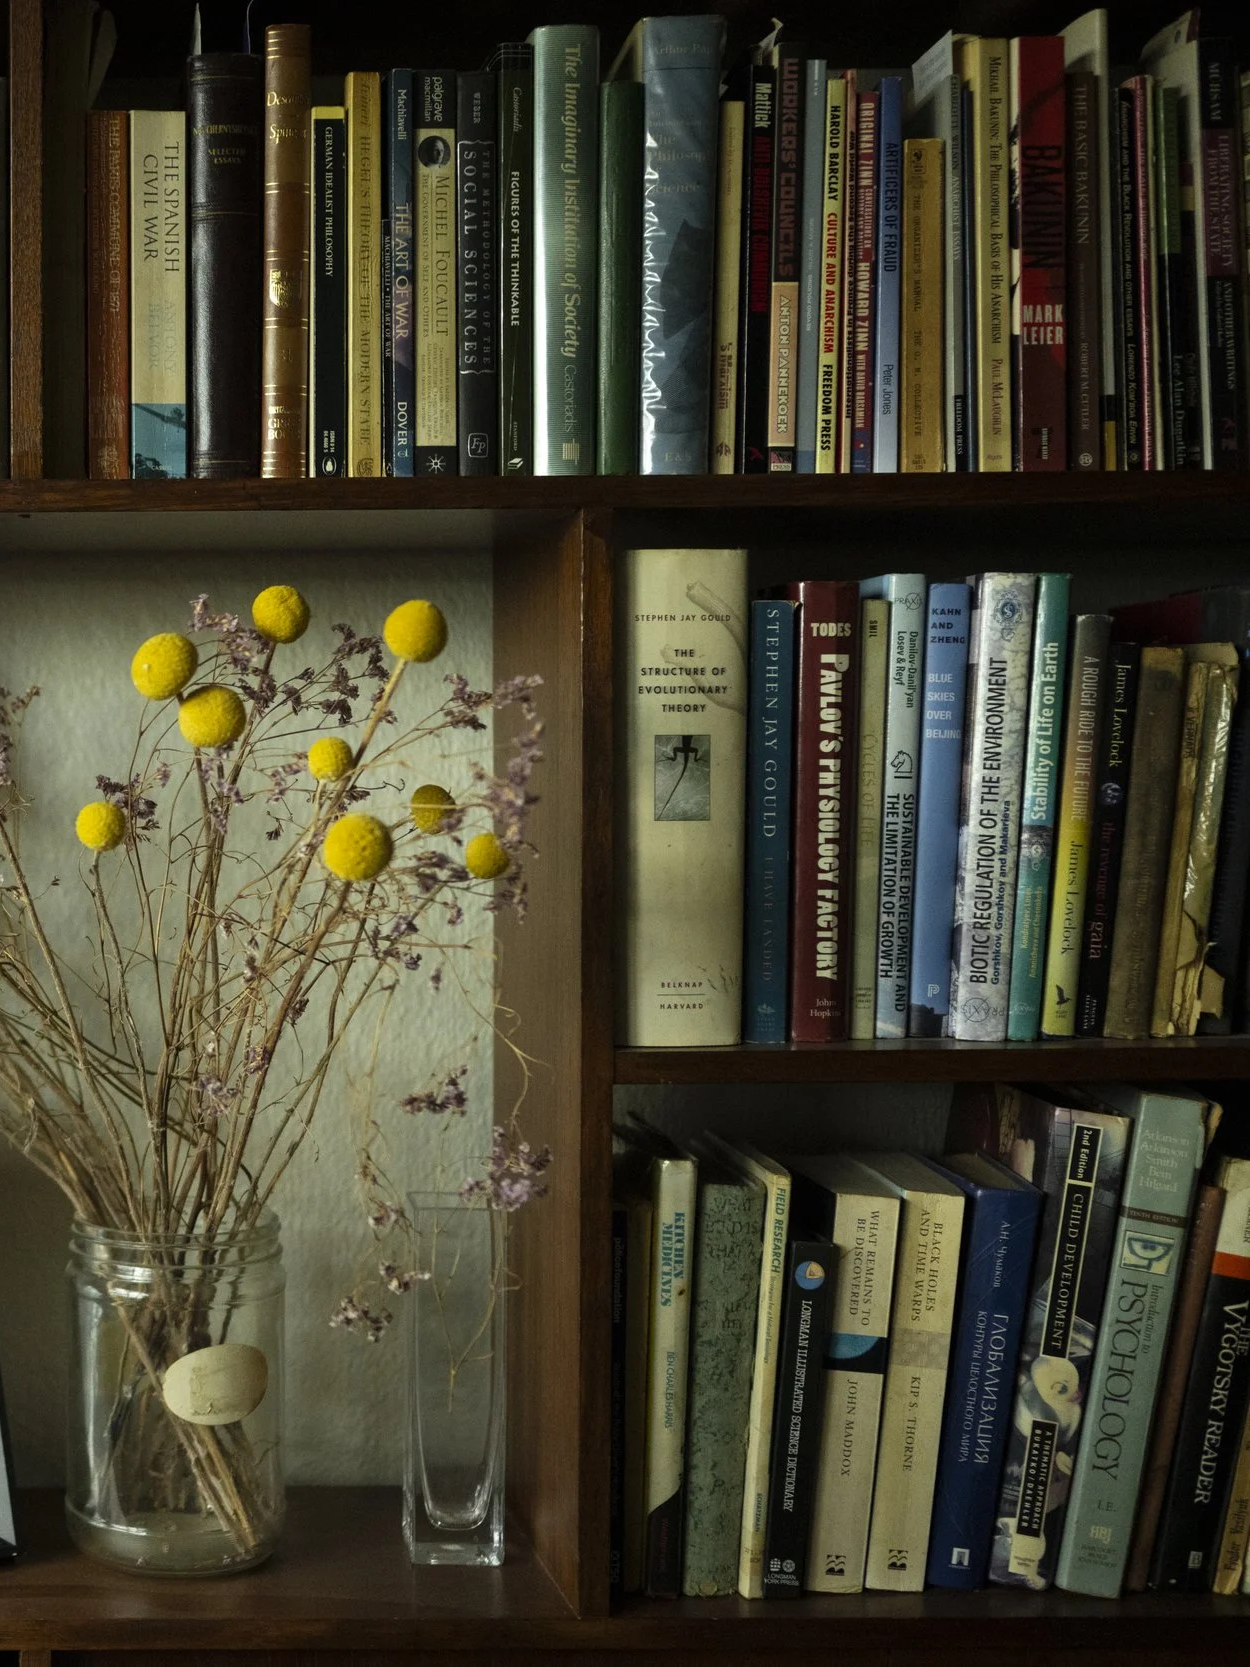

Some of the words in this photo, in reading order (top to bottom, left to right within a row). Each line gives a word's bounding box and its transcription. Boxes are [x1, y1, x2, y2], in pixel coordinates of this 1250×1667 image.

[565, 44, 580, 77] The
[397, 89, 406, 140] Machiavelli
[424, 77, 432, 122] macmillan
[431, 77, 444, 122] palgrave
[1075, 85, 1087, 115] THE
[325, 127, 334, 170] GERMAN
[560, 83, 580, 173] Imaginary
[829, 106, 840, 150] HAROLD
[1075, 119, 1087, 167] BASIC
[143, 154, 158, 208] CIVIL
[164, 142, 179, 182] THE
[828, 153, 839, 200] BARCLAY
[884, 142, 897, 209] ARTIFICERS
[325, 172, 334, 215] IDEALIST
[463, 150, 477, 235] SOCIAL
[511, 171, 520, 217] FIGURES
[1075, 171, 1088, 244] BAKUNIN
[143, 217, 158, 260] WAR
[164, 187, 179, 273] SPANISH
[395, 203, 408, 235] THE
[511, 219, 520, 233] OF
[826, 213, 837, 258] CULTURE
[885, 215, 897, 230] OF
[324, 217, 334, 277] PHILOSOPHY
[395, 239, 408, 270] ART
[510, 236, 519, 257] THE
[884, 235, 897, 272] FRAUD
[395, 274, 409, 298] OF
[510, 260, 520, 326] THINKABLE
[563, 272, 580, 288] of
[825, 263, 836, 286] AND
[396, 301, 408, 339] WAR
[464, 250, 477, 364] SCIENCES
[560, 293, 580, 358] Society
[778, 296, 791, 345] ANTON
[824, 290, 836, 353] ANARCHISM
[1022, 304, 1064, 324] MARK
[1022, 327, 1064, 345] LEIER
[776, 348, 790, 433] PANNEKOEK
[821, 365, 833, 415] FREEDOM
[882, 364, 894, 385] Peter
[563, 365, 577, 432] Castoriadis
[882, 388, 893, 414] Jones
[397, 402, 408, 445] DOVER
[820, 419, 831, 451] PRESS
[868, 620, 877, 638] SMIL
[765, 609, 779, 710] STEPHEN
[1113, 661, 1131, 703] James
[638, 686, 728, 694] EVOLUTIONARY
[820, 653, 848, 752] PAVLOV'S
[762, 717, 778, 750] JAY
[983, 658, 1007, 771] ENVIRONMENT
[1108, 707, 1128, 767] Lovelock
[762, 760, 777, 838] GOULD
[981, 776, 997, 804] THE
[817, 758, 841, 883] PHYSIOLOGY
[979, 810, 995, 829] OF
[972, 834, 994, 932] REGULATION
[815, 889, 837, 981] FACTORY
[969, 937, 989, 983] BIOTIC
[1066, 1193, 1083, 1239] CHILD
[991, 1245, 1008, 1288] Чумаков
[1051, 1243, 1077, 1349] DEVELOPMENT
[798, 1300, 812, 1346] LONGMAN
[791, 1348, 808, 1413] ILLUSTRATED
[844, 1380, 858, 1416] JOHN
[910, 1376, 921, 1398] KIP
[973, 1313, 1008, 1464] ГЛОБАЛИЗАЦИЯ
[1092, 1281, 1142, 1479] PSYCHOLOGY
[908, 1402, 920, 1412] S.
[788, 1416, 802, 1454] SCIENCE
[840, 1419, 857, 1478] MADDOX
[902, 1417, 918, 1472] THORNE
[782, 1456, 800, 1511] DICTIONARY
[1193, 1420, 1222, 1504] READER
